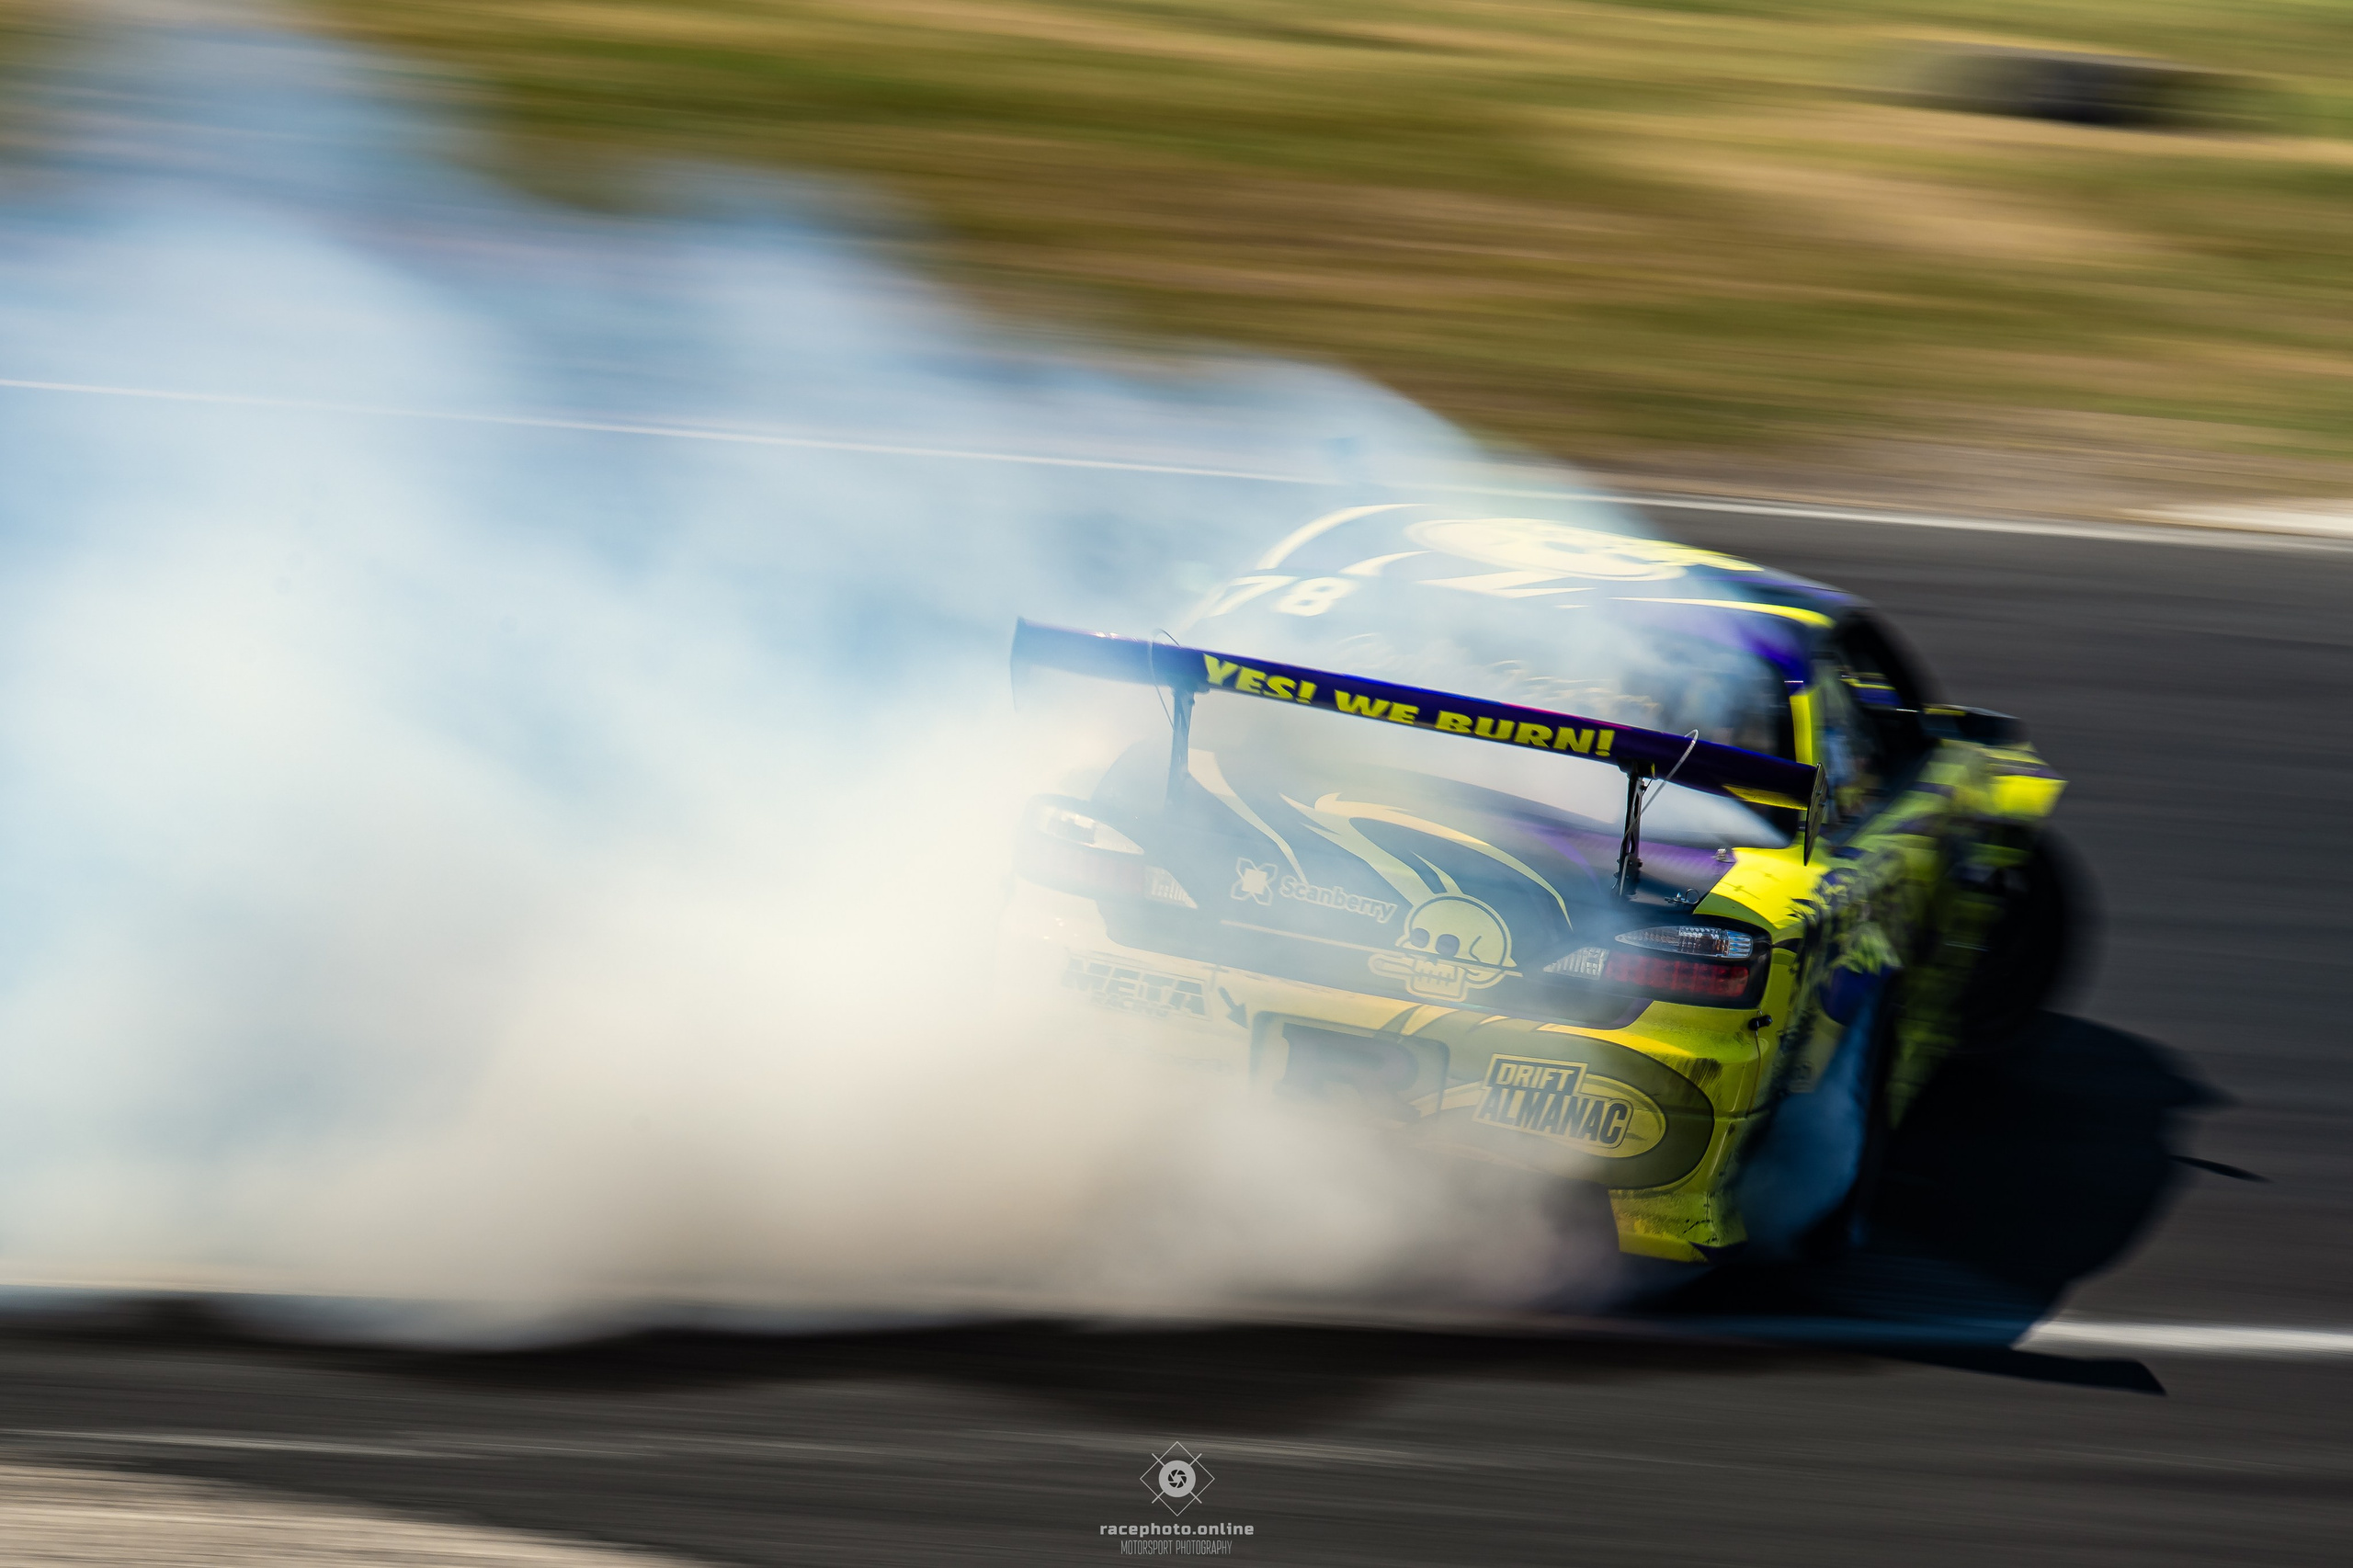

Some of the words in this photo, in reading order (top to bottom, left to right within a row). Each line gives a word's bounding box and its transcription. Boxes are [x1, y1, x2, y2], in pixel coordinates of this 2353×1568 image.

[1207, 574, 1360, 619] 78
[1203, 652, 1317, 704] YES!
[1334, 689, 1420, 725] WE
[1434, 710, 1616, 757] BURN!
[1279, 875, 1397, 923] Scanberry
[1495, 1062, 1575, 1092] DRIFT
[1477, 1087, 1629, 1145] ALMANAC
